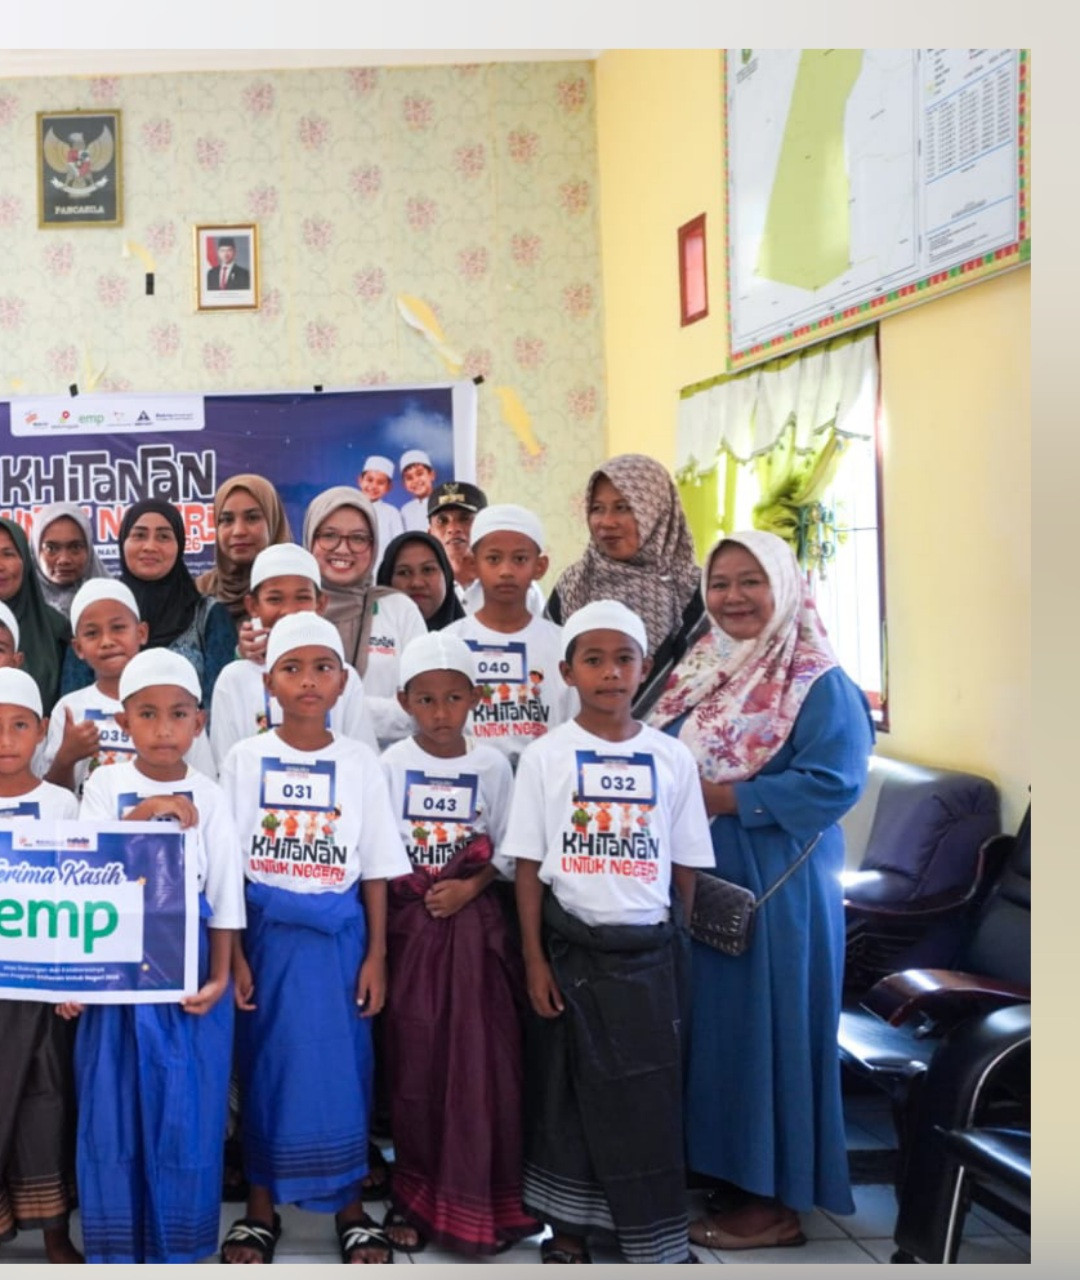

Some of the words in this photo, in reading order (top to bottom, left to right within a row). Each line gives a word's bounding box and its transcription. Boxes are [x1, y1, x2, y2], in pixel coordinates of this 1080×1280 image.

[79, 413, 104, 426] emp
[478, 661, 509, 673] 040
[601, 776, 636, 791] 032
[283, 784, 312, 799] 031
[423, 797, 456, 812] 043
[63, 861, 123, 885] Kasih
